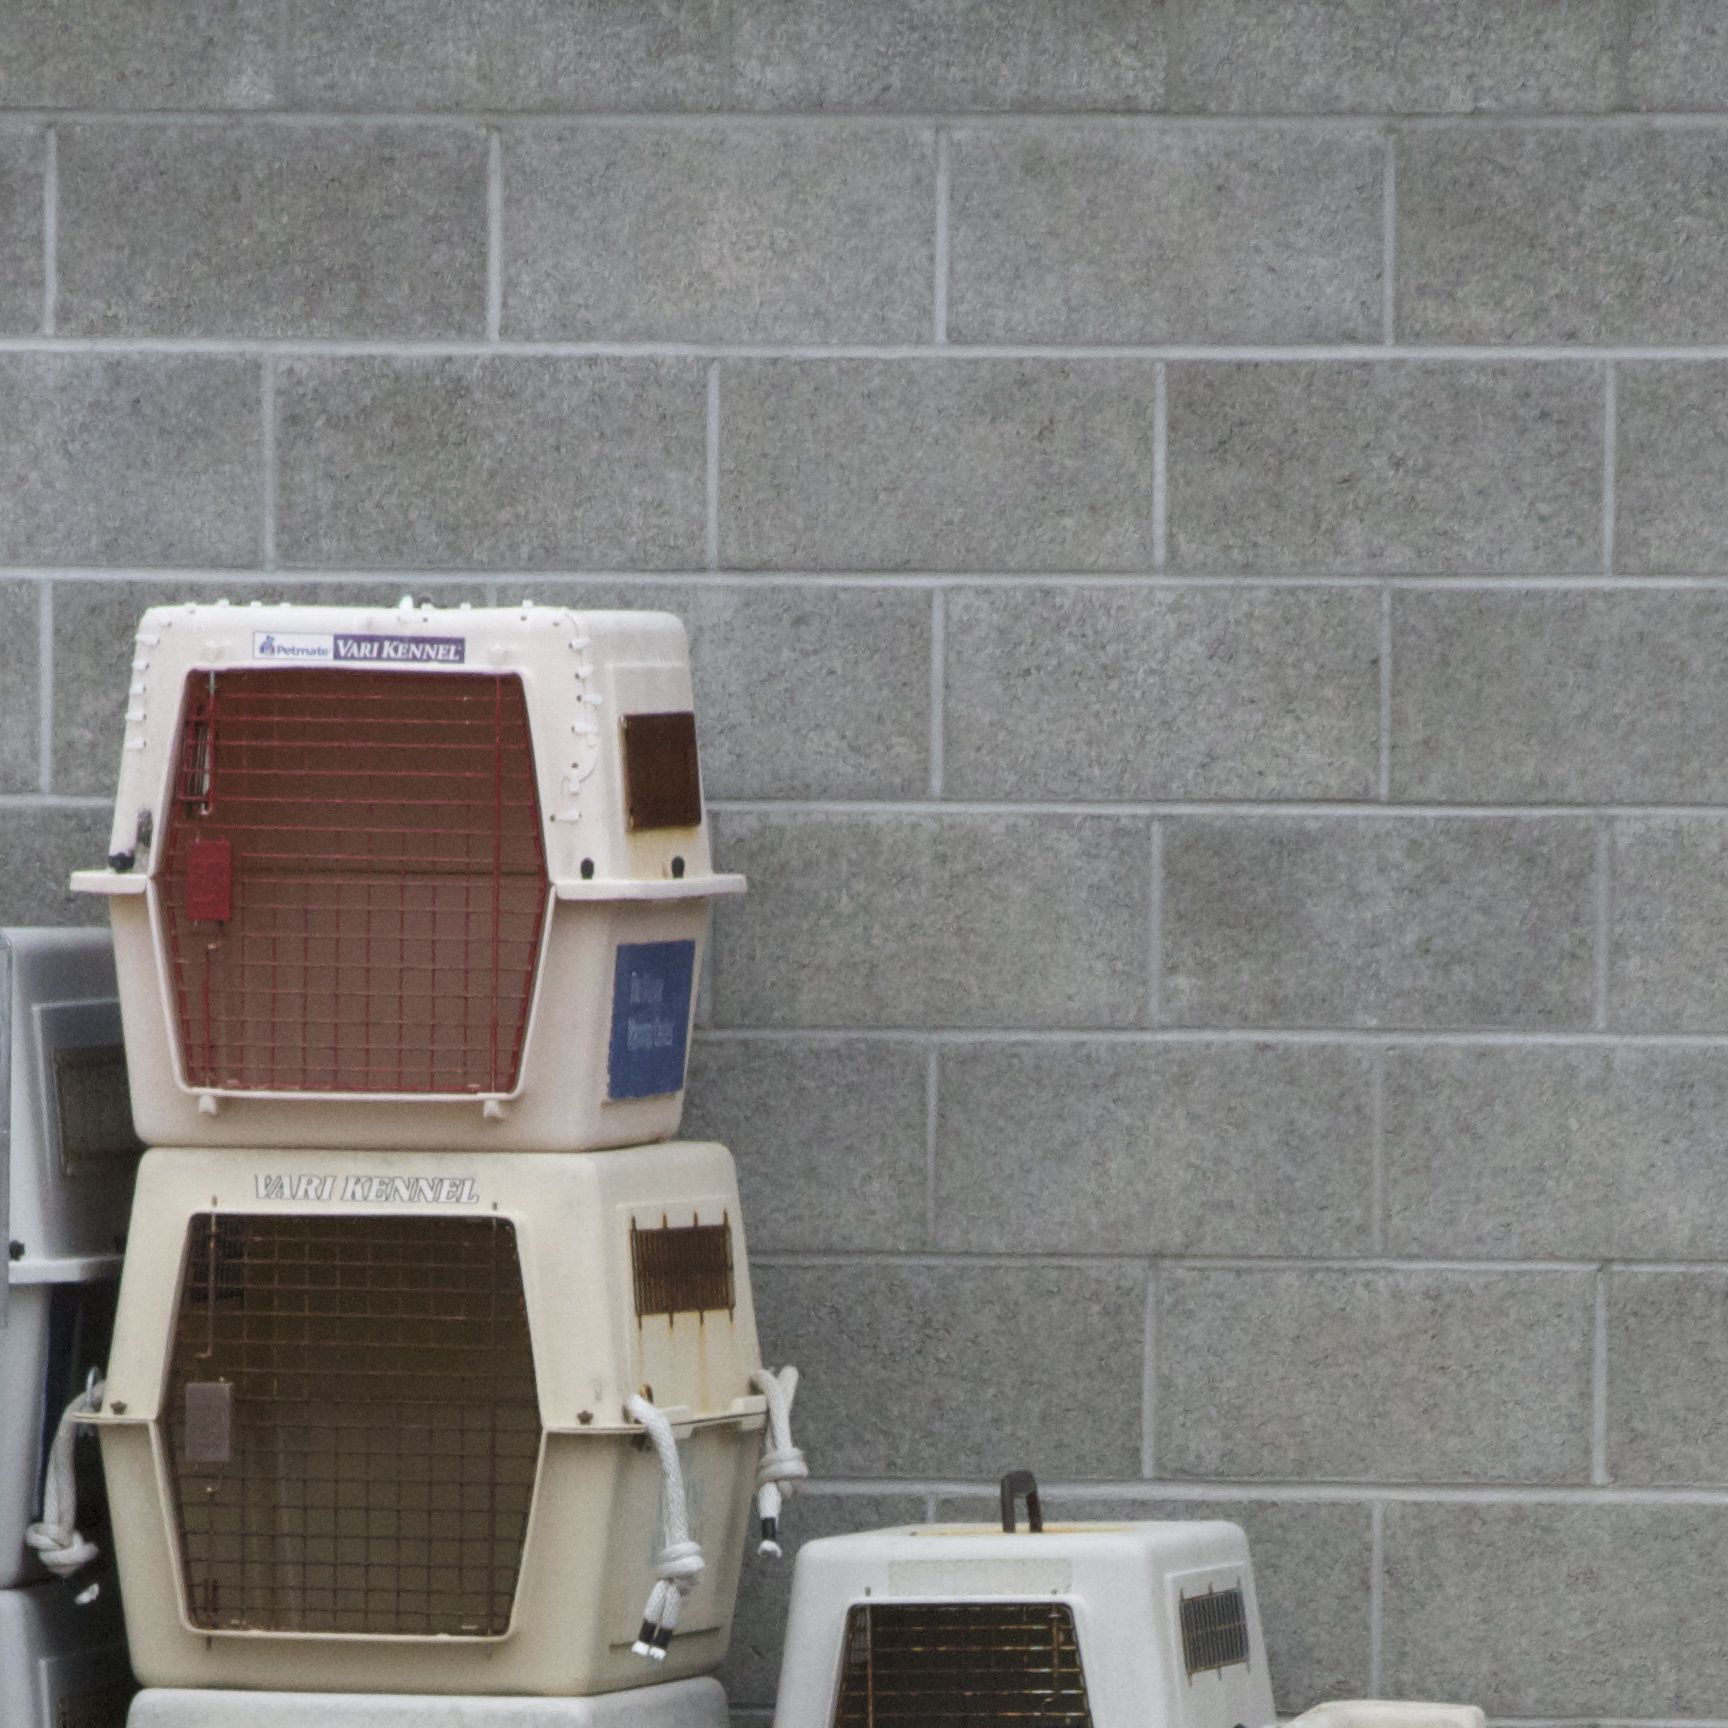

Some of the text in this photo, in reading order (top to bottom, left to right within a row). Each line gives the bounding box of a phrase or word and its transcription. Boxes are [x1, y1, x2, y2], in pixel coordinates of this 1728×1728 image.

[277, 639, 460, 661] Petmate VARI KENNEL
[255, 1174, 480, 1205] VARI KENNEL
